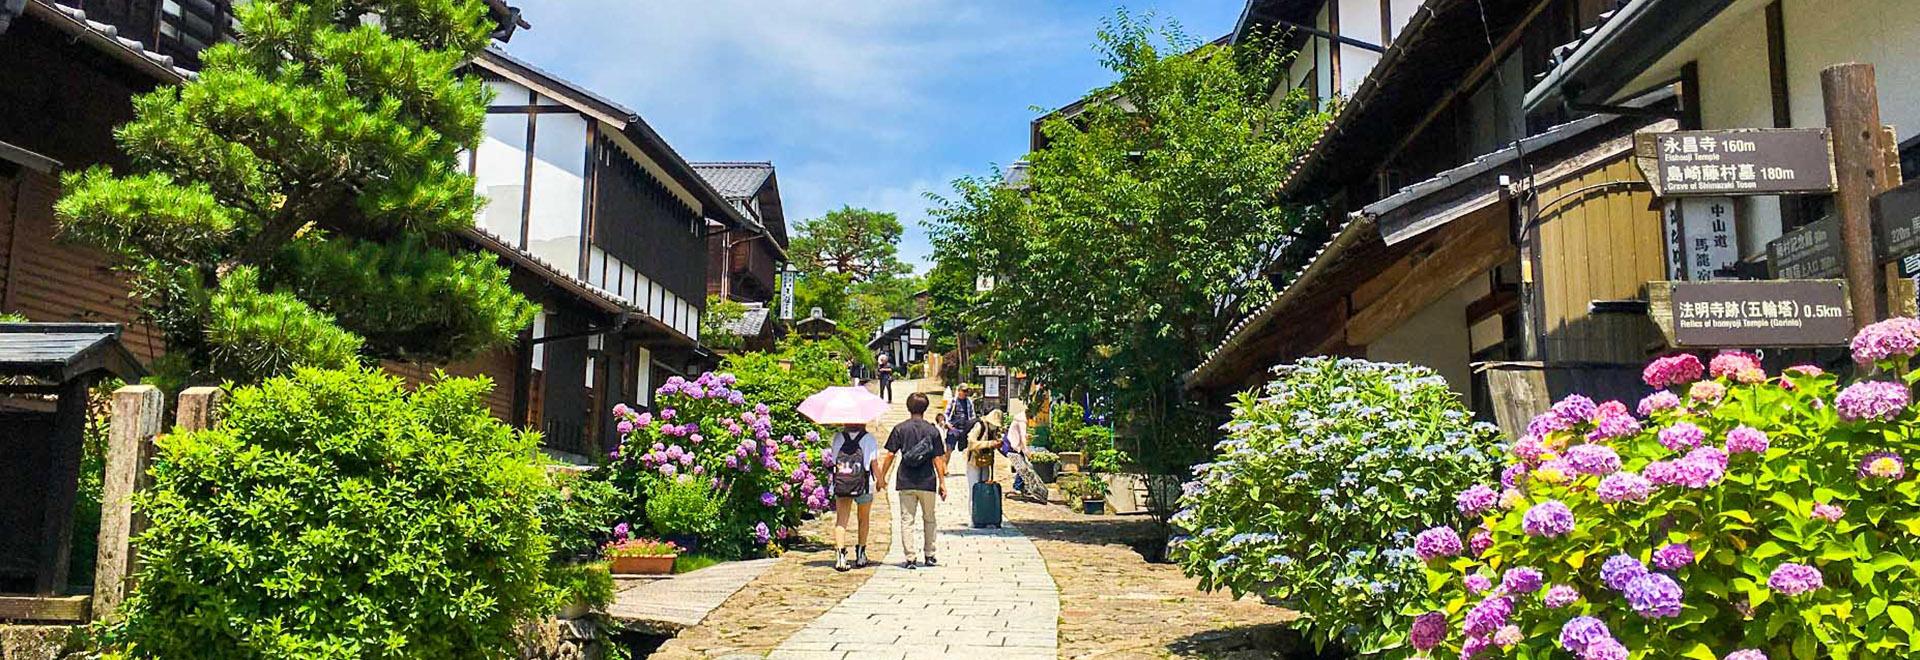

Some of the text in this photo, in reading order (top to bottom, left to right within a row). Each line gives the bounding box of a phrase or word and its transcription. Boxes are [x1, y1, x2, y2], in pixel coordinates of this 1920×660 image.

[1664, 136, 1756, 153] 永昌寺 160m
[1694, 153, 1720, 161] Temple
[1667, 164, 1795, 182] 島崎藤村墓 180m
[1668, 181, 1757, 191] Grave of Shimazaki Toson
[1711, 203, 1728, 248] 中山道
[1803, 304, 1842, 318] 0.5km
[1680, 319, 1703, 328] Relics
[1704, 319, 1711, 328] of
[1743, 318, 1769, 328] Temple
